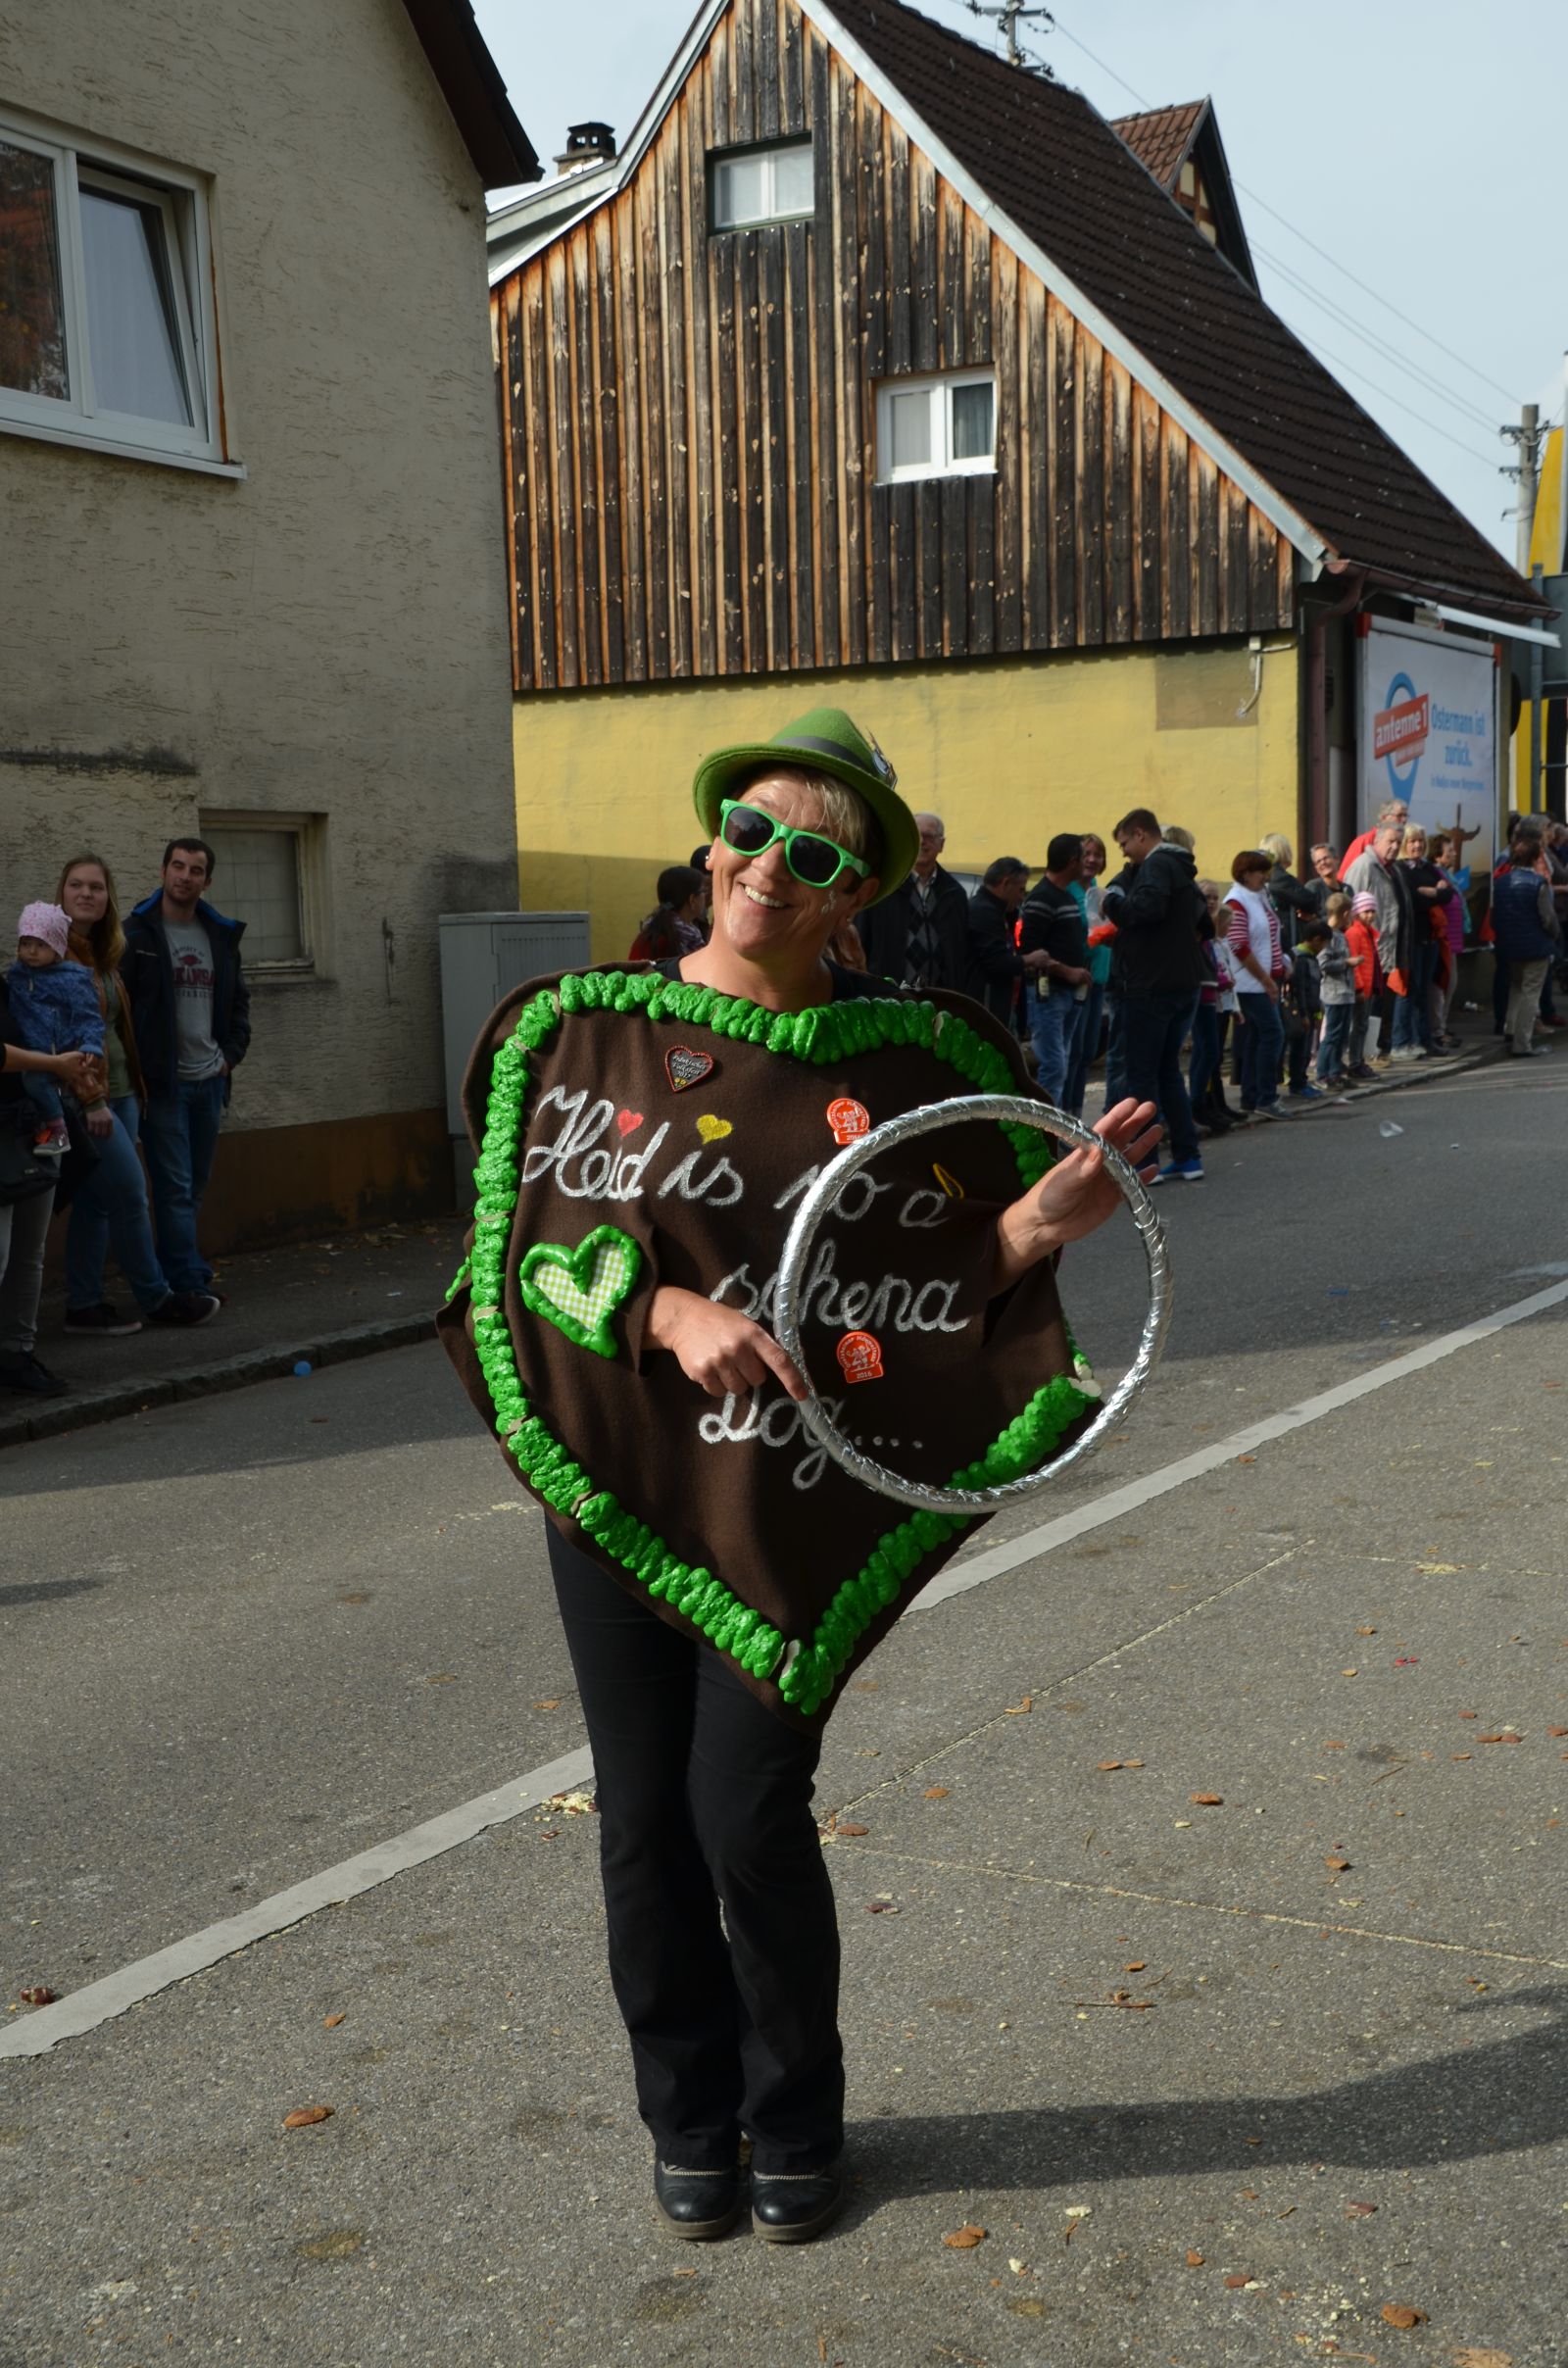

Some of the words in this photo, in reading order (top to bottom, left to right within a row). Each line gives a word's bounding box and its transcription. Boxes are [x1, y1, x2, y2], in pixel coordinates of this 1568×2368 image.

[1375, 710, 1422, 749] antenne
[1422, 702, 1428, 728] 1
[1431, 704, 1474, 734] Ostermann
[1475, 711, 1486, 737] ist
[657, 1114, 744, 1207] is
